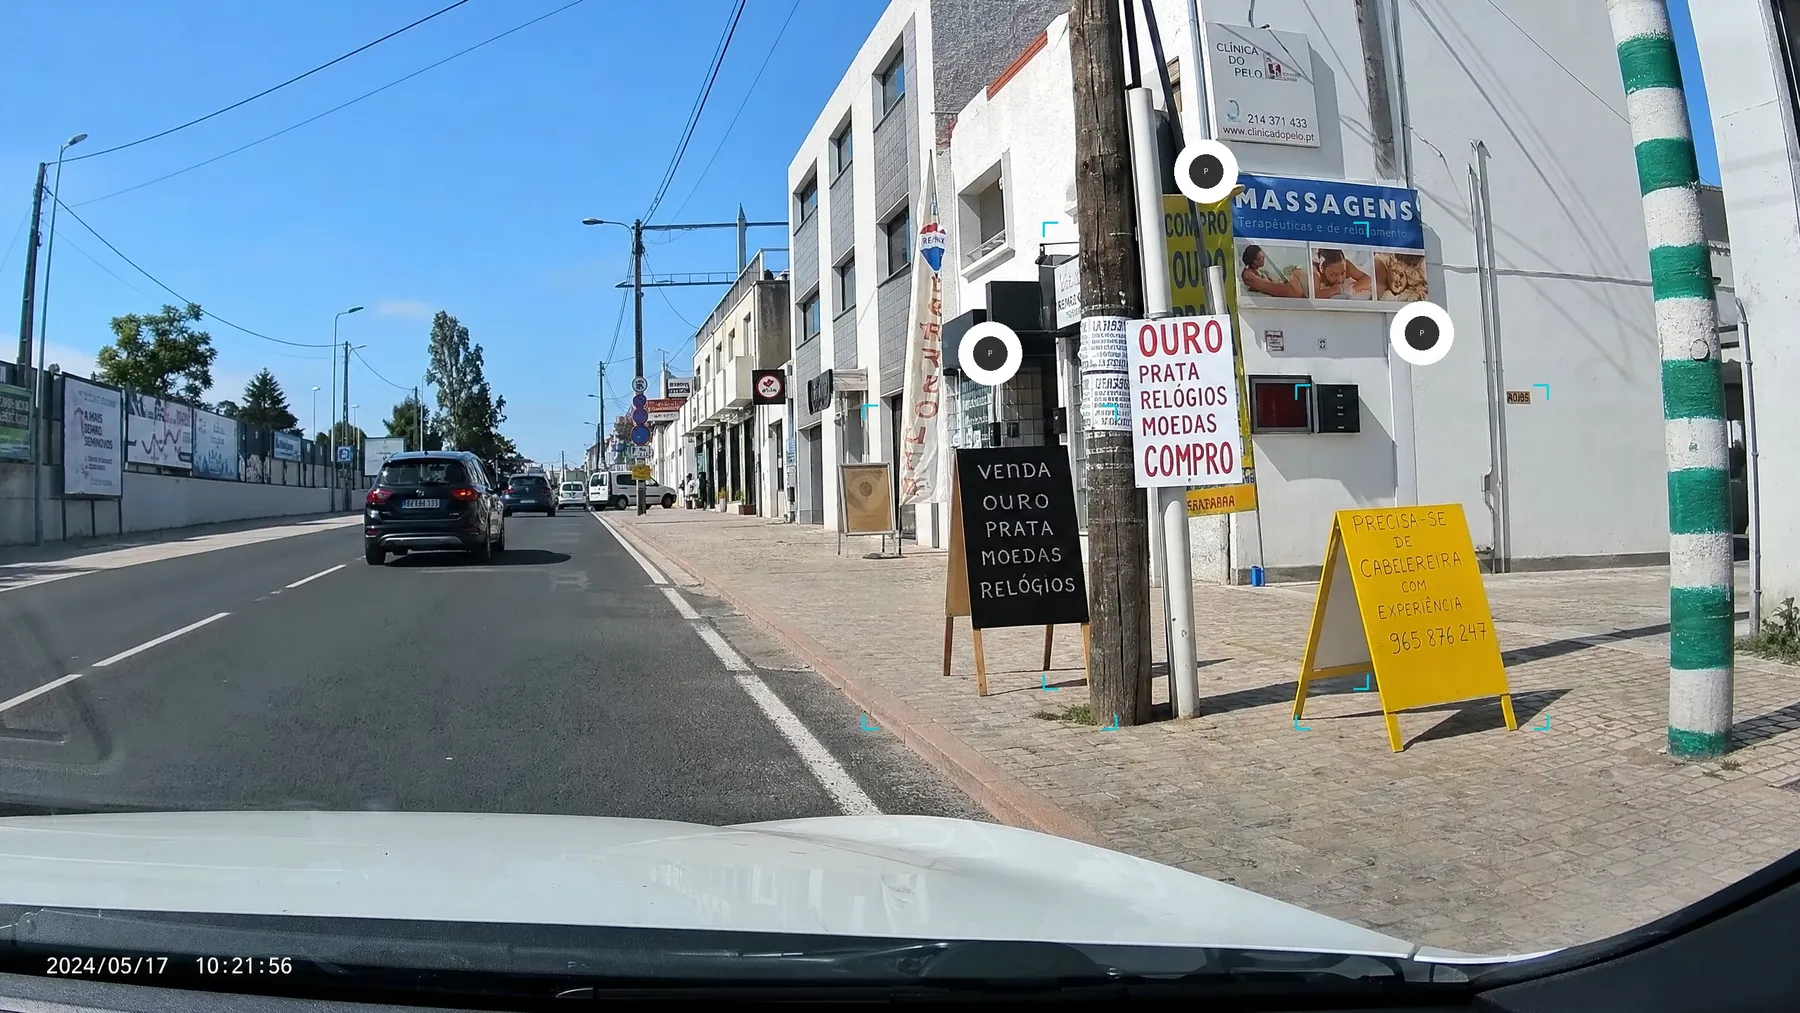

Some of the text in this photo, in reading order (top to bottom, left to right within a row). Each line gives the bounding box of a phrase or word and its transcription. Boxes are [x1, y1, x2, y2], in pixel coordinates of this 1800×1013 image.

[1216, 41, 1259, 56] CLÍNICA
[1228, 55, 1245, 66] DO
[1234, 67, 1263, 79] PELO
[1247, 113, 1308, 129] 214 371 433
[1222, 126, 1315, 143] www.clinicadopelo.pt
[1235, 188, 1413, 221] MASSAGENS
[1316, 224, 1323, 233] e
[1327, 223, 1340, 234] de
[1344, 225, 1407, 239] relaamento
[1138, 320, 1223, 357] OURO
[1139, 361, 1200, 383] PRATA
[1140, 383, 1228, 410] RELÓGIOS
[1142, 413, 1217, 436] MOEDAS
[1144, 441, 1233, 477] COMPRO
[983, 493, 1049, 511] OURO
[985, 520, 1054, 538] PRATA
[1393, 535, 1413, 549] DE
[981, 547, 1062, 566] MOEDAS
[1360, 551, 1462, 578] CABELEREIRA
[980, 573, 1076, 599] RELÓGIOS
[1401, 579, 1427, 593] COM
[1377, 595, 1463, 620] EXPERIÊNCIA
[1389, 622, 1487, 655] 965 876 247
